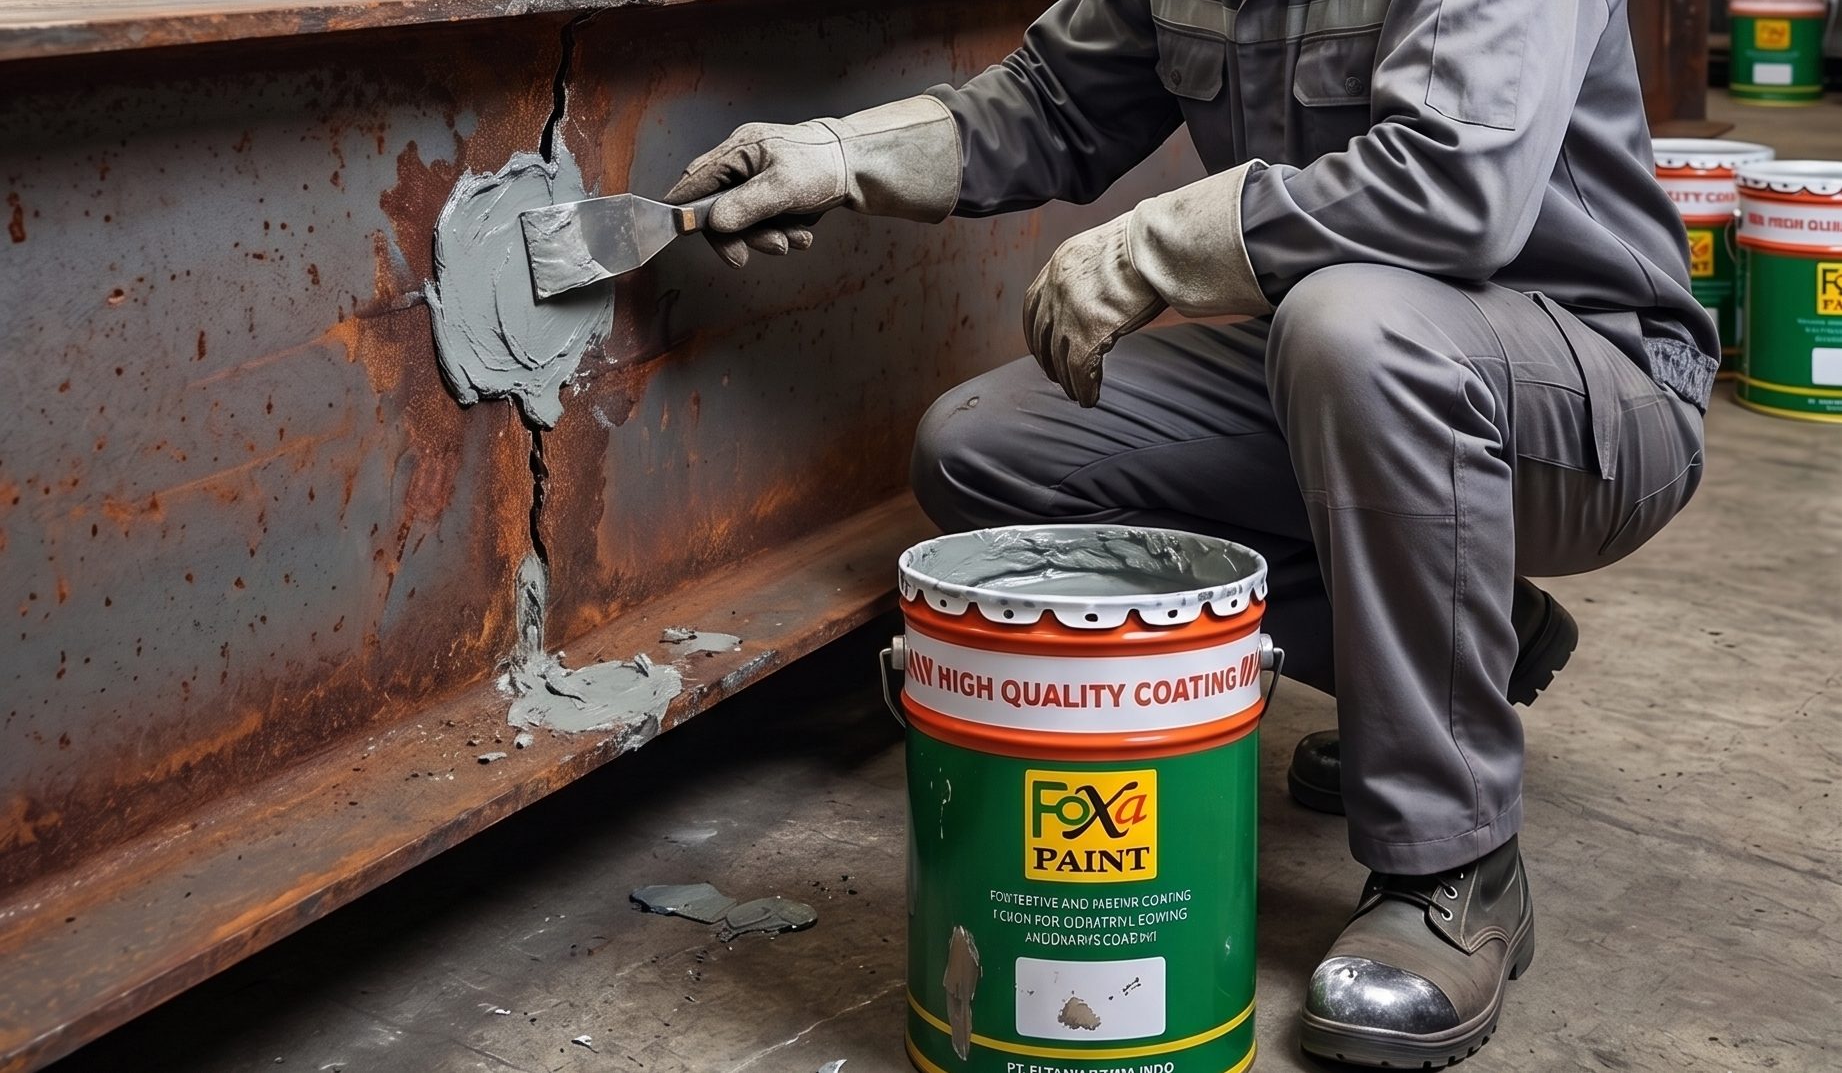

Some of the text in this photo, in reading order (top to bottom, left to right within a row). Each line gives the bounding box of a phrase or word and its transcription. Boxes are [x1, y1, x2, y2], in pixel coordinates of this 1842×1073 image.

[937, 664, 1237, 709] HIGH QUALITY COATING
[1033, 846, 1150, 873] PAINT
[1061, 897, 1089, 910] AND
[1139, 1061, 1175, 1073] INDO
